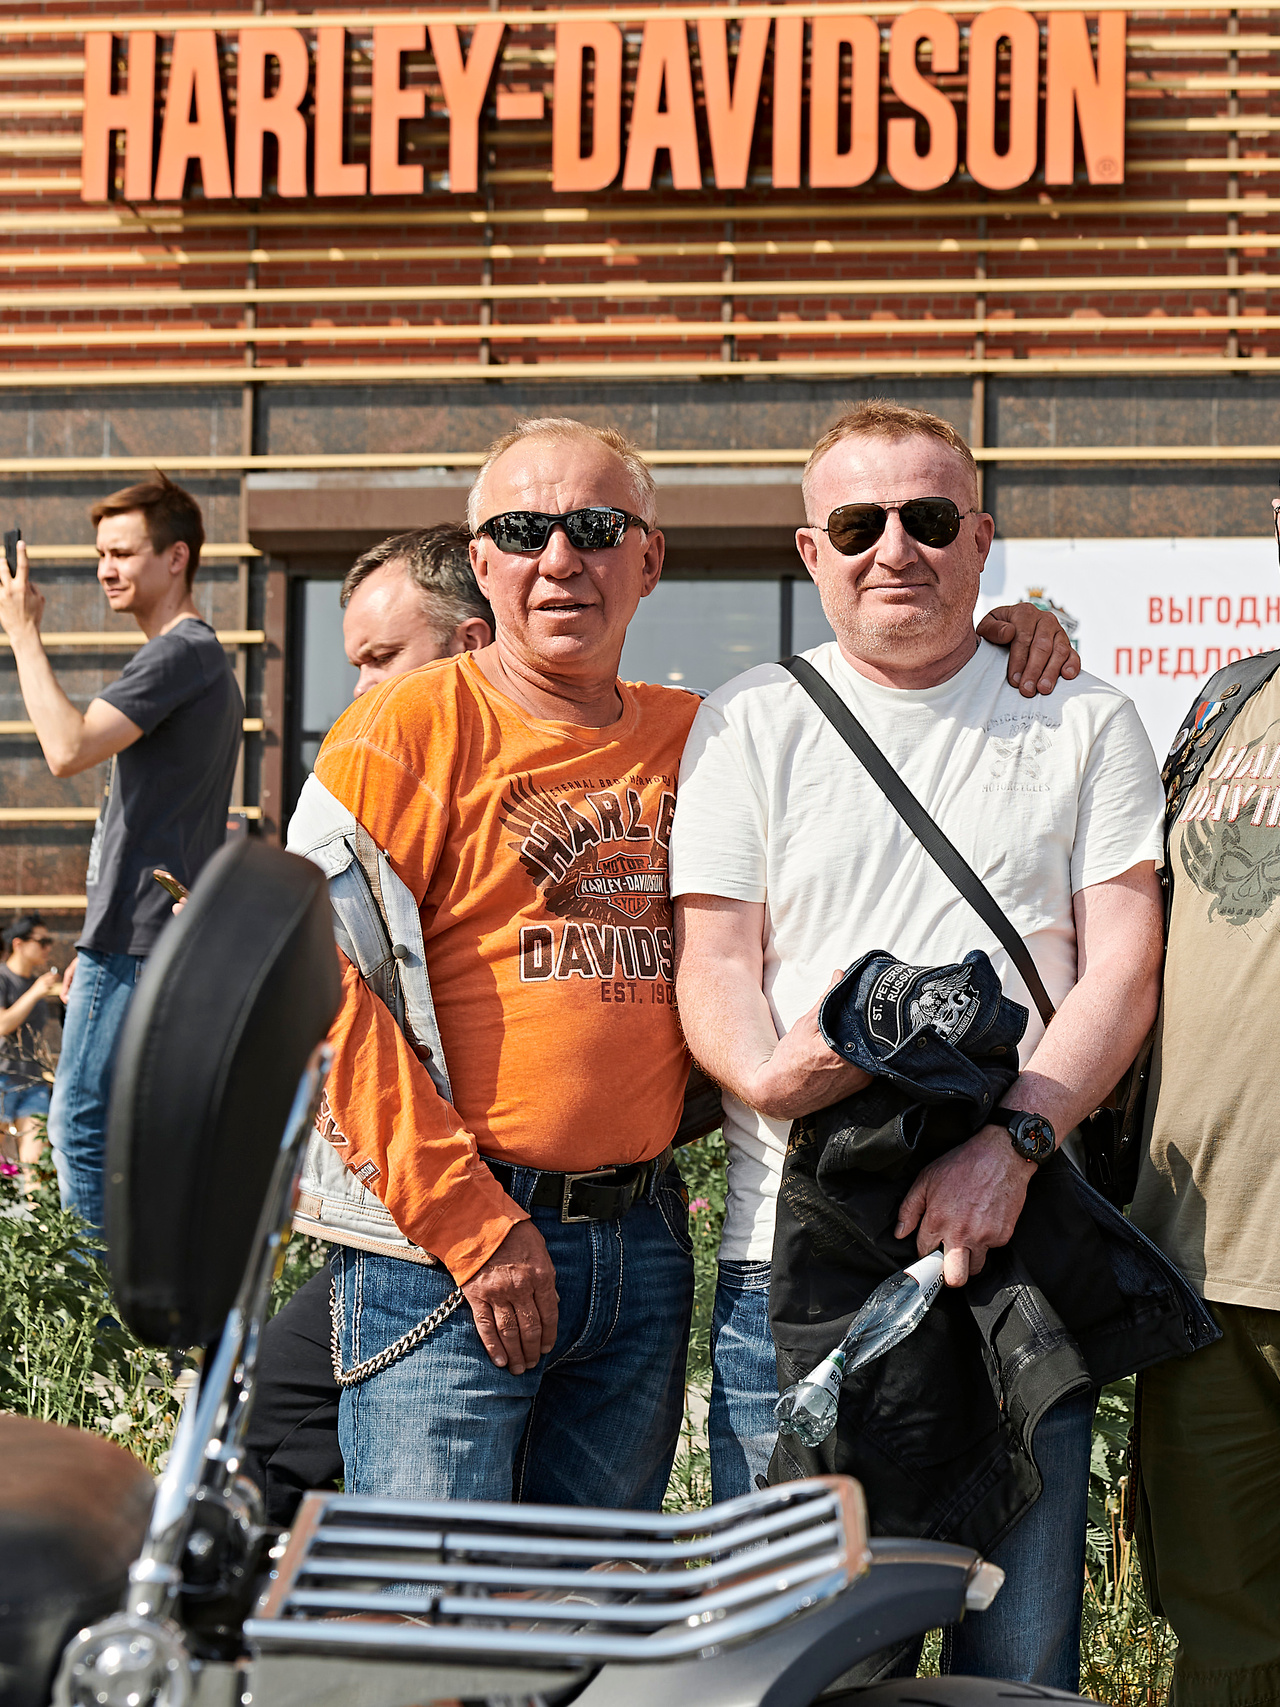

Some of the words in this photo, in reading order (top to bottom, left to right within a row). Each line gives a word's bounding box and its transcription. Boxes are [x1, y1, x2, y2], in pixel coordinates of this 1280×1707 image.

[81, 8, 1126, 201] HARLEY-DAVIDSON
[550, 778, 595, 798] ETERNAL
[599, 774, 671, 790] BROTHERHOOD
[602, 856, 646, 874] MOTOR
[580, 874, 665, 894] HARLEY-DAVIDSON
[601, 981, 643, 1005] EST.
[887, 968, 917, 1003] RUSSIA
[872, 1004, 883, 1021] ST.
